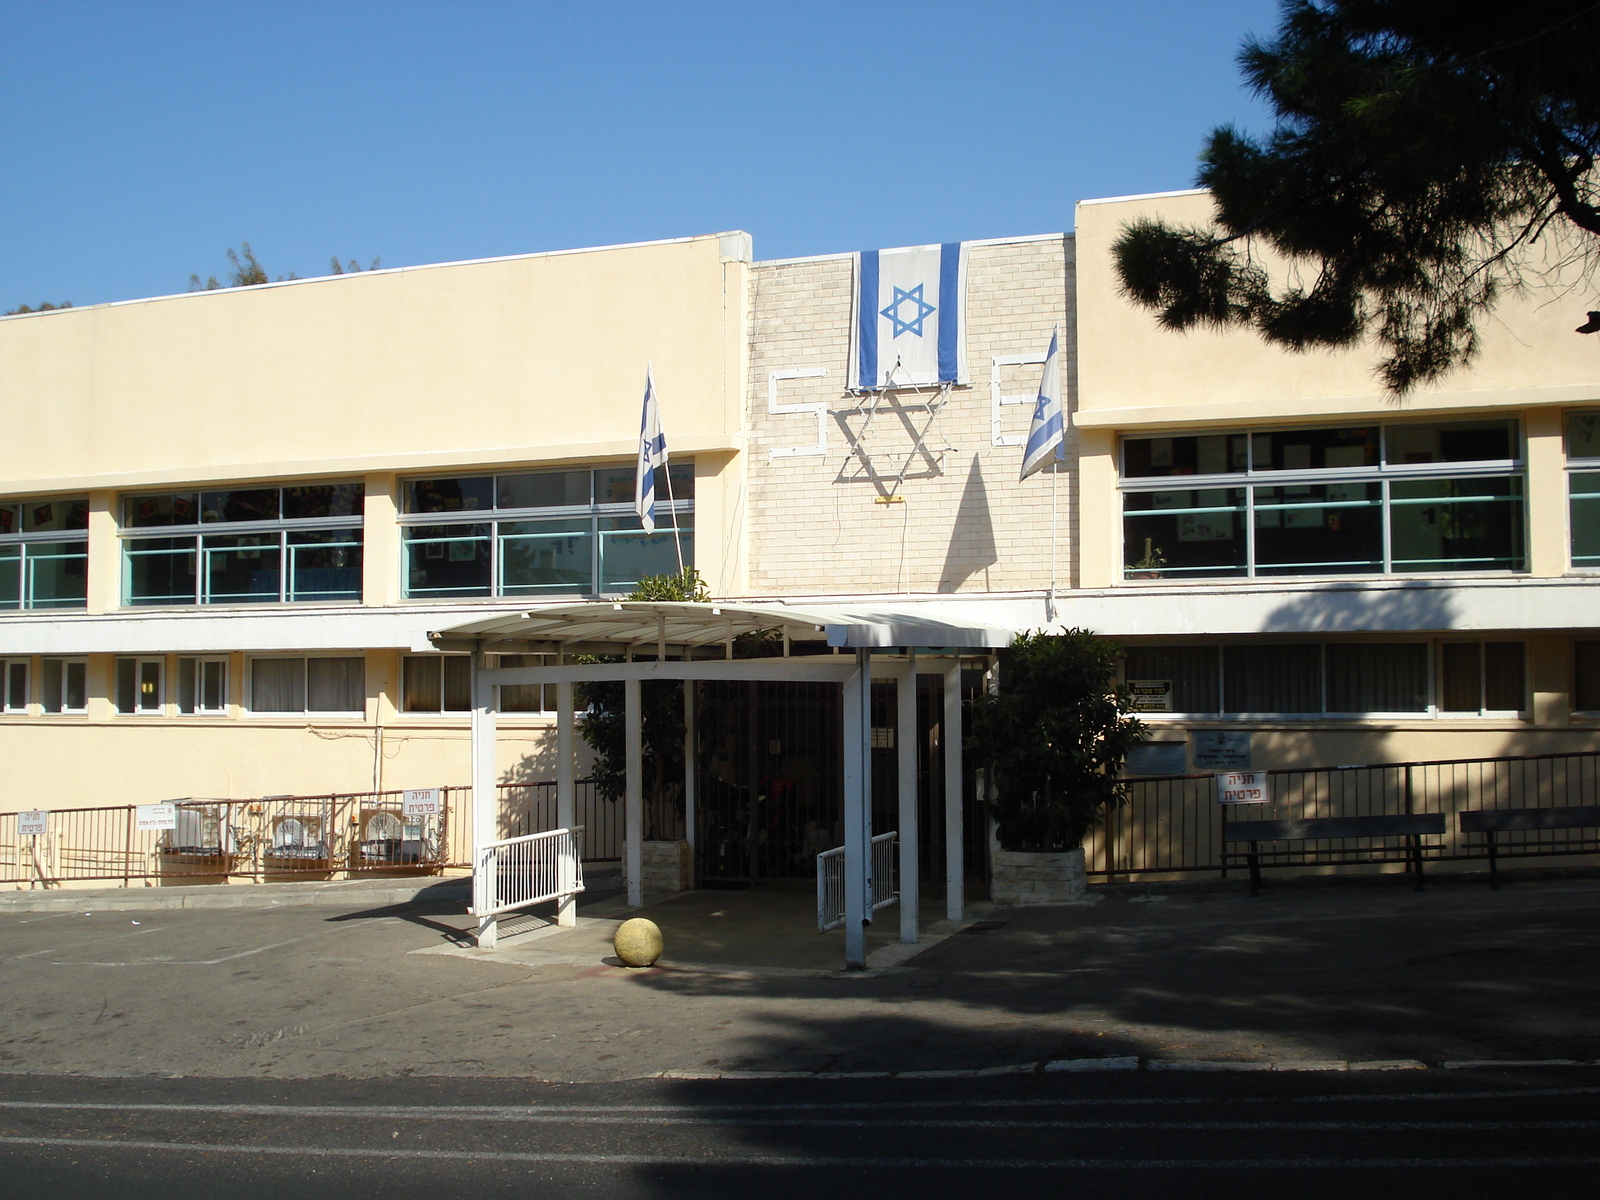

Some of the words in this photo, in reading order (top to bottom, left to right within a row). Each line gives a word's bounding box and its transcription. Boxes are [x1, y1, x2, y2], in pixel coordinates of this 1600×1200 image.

[1229, 775, 1255, 785] חניה
[412, 791, 430, 800] חניה
[1224, 789, 1261, 800] פרטית
[409, 803, 434, 813] פרטית
[25, 813, 40, 821] חניה
[21, 824, 42, 832] פרטית
